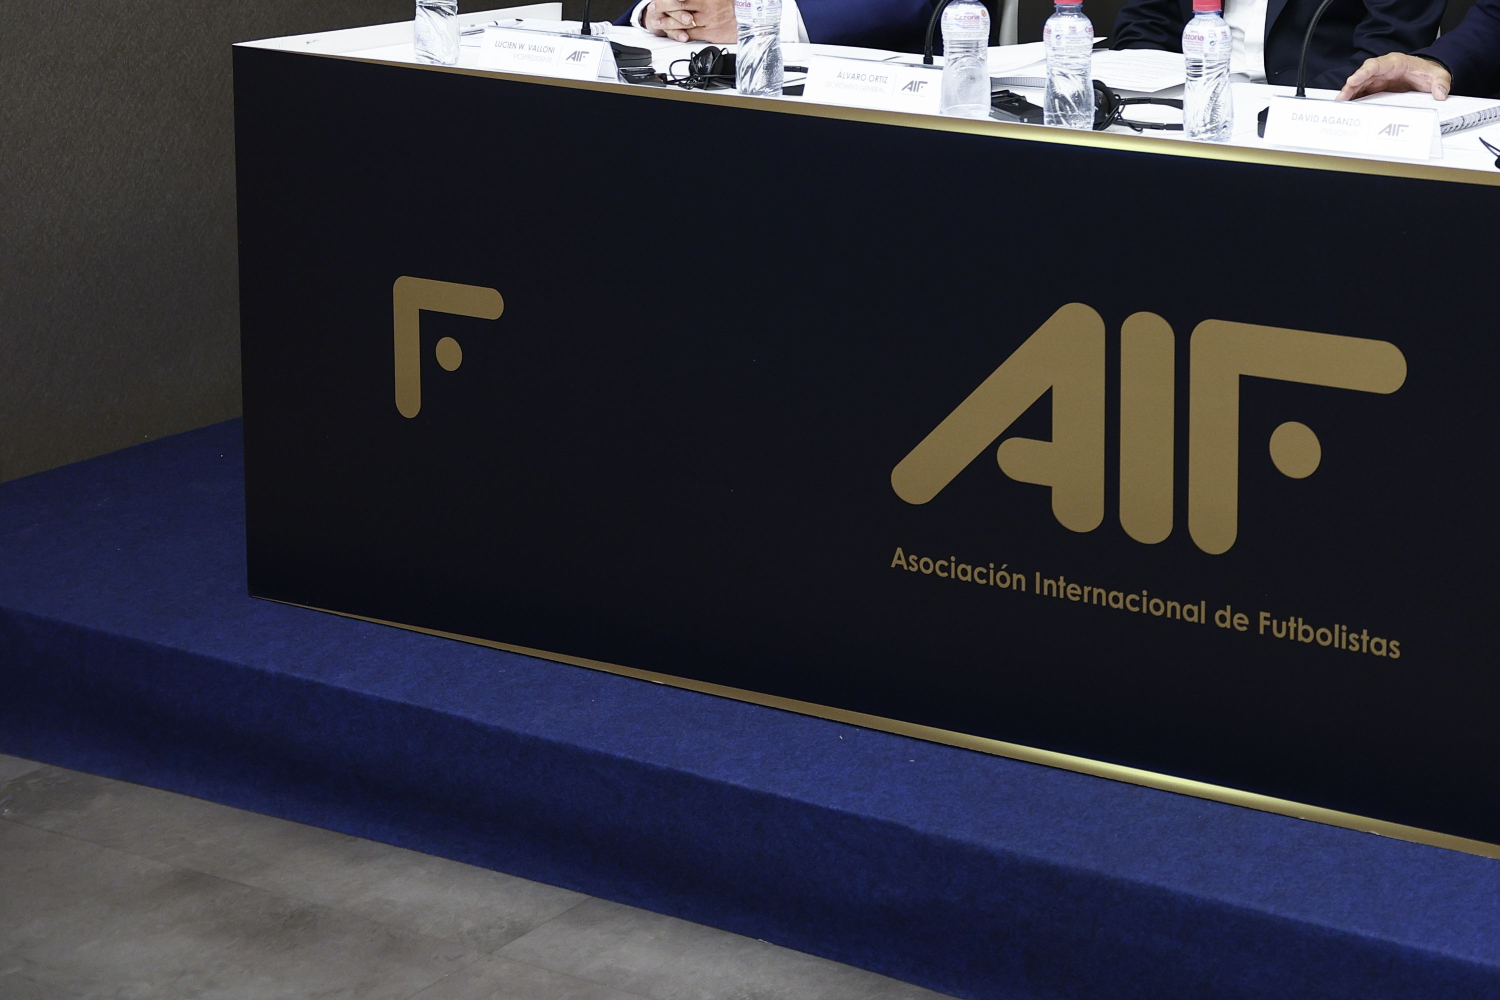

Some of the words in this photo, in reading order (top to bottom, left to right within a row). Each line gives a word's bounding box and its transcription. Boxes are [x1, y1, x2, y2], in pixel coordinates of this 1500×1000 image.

[494, 40, 517, 50] LUCIEN
[518, 43, 526, 51] W.
[528, 44, 556, 54] VALLONI
[565, 49, 590, 62] AIF
[837, 69, 867, 82] ÁLVARO
[868, 73, 889, 84] ORTIZ
[901, 80, 928, 93] AIF
[1291, 112, 1320, 123] DAVID
[1321, 116, 1361, 128] AGANZO
[1378, 123, 1410, 137] AIF
[891, 302, 1408, 556] AIF
[891, 547, 1026, 591] Asociación
[1035, 572, 1206, 625] Internacional
[1214, 605, 1250, 632] de
[1259, 611, 1401, 660] Futbolistas
